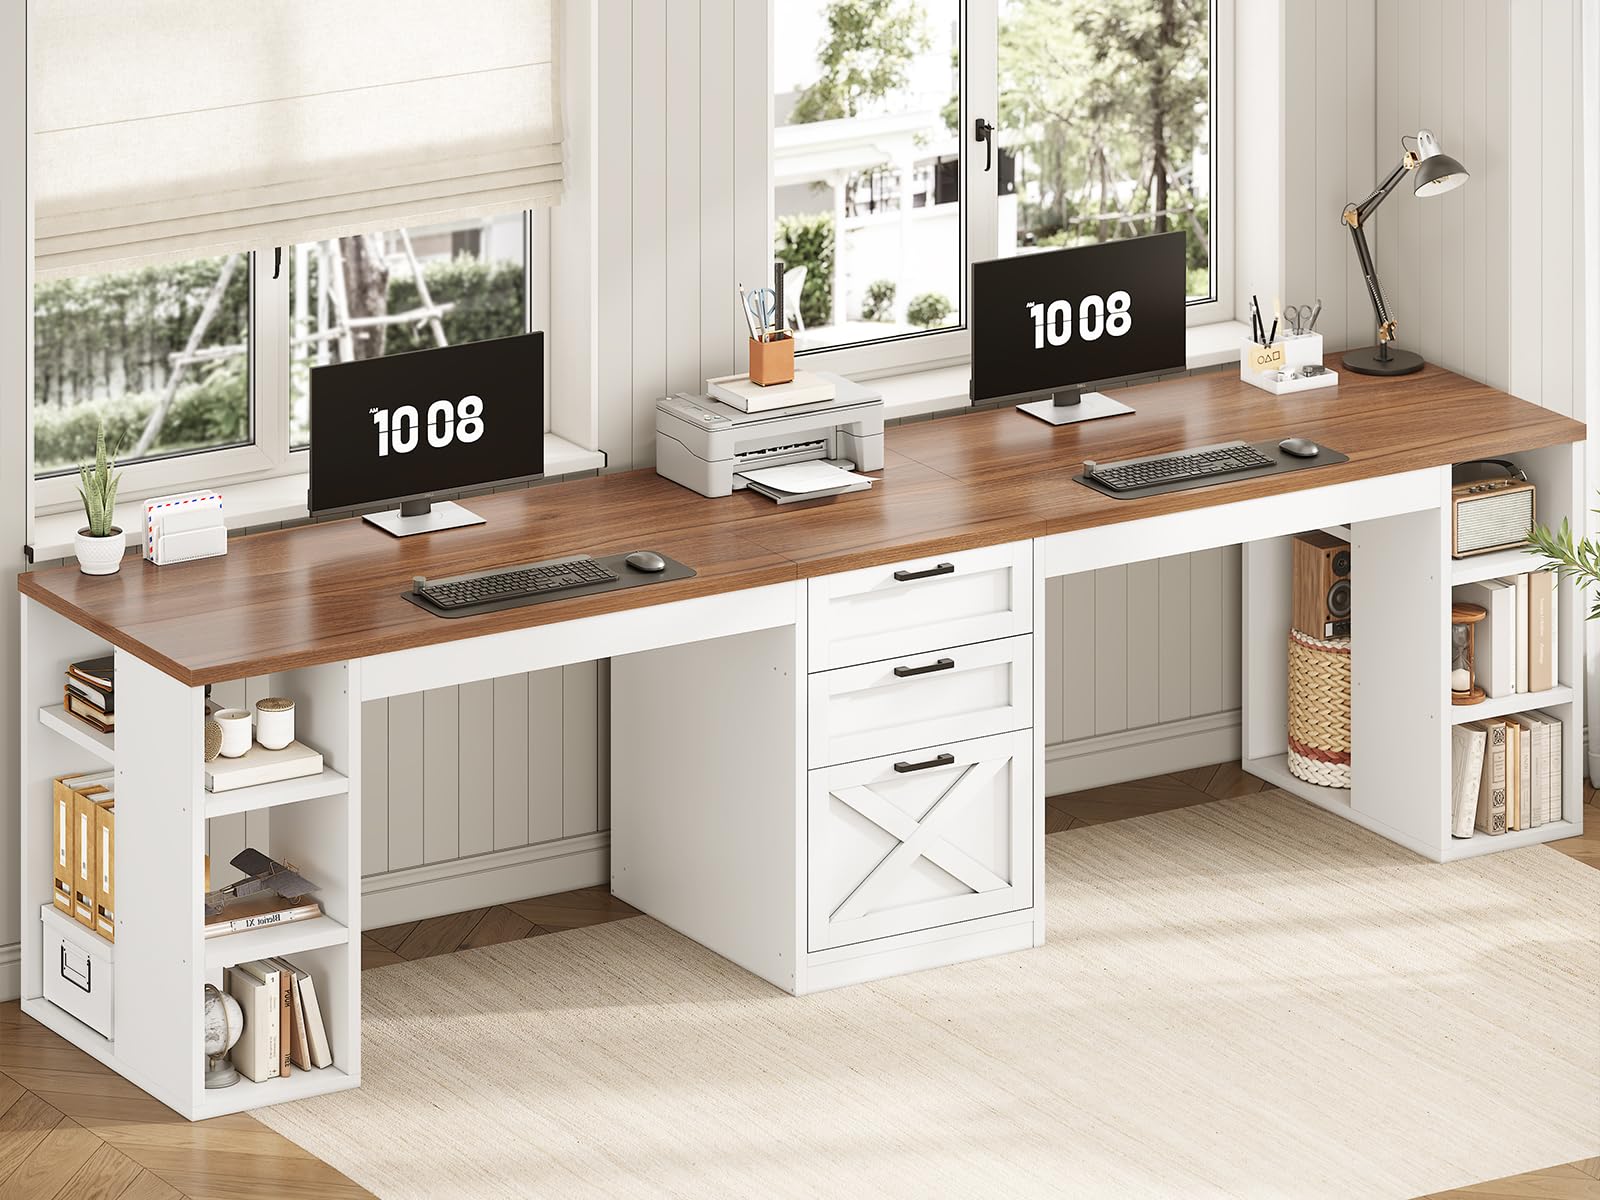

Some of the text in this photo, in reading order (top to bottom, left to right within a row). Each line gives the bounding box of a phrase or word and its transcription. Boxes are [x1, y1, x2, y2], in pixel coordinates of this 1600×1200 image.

[1030, 290, 1132, 350] 10 08
[373, 395, 485, 457] 10 08
